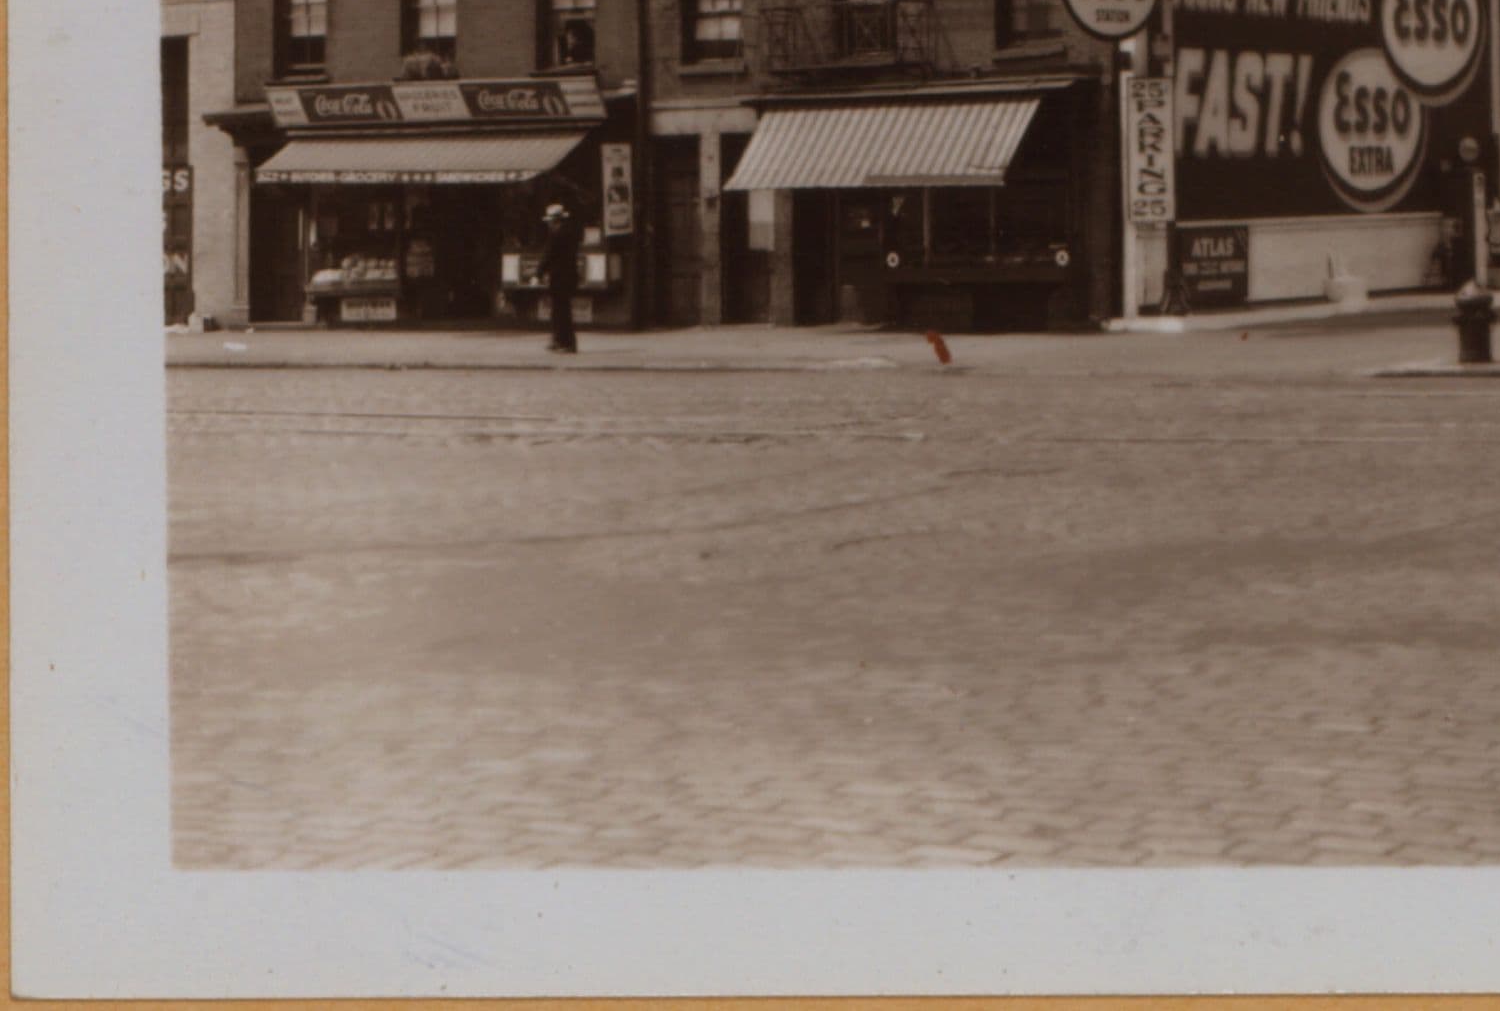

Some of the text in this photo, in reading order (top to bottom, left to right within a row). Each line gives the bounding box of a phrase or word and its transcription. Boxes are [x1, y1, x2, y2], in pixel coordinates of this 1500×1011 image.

[1174, 47, 1314, 157] FAST!
[1136, 100, 1166, 195] PARKING
[1349, 145, 1395, 177] EXTRA
[1192, 237, 1235, 257] ATLAS
